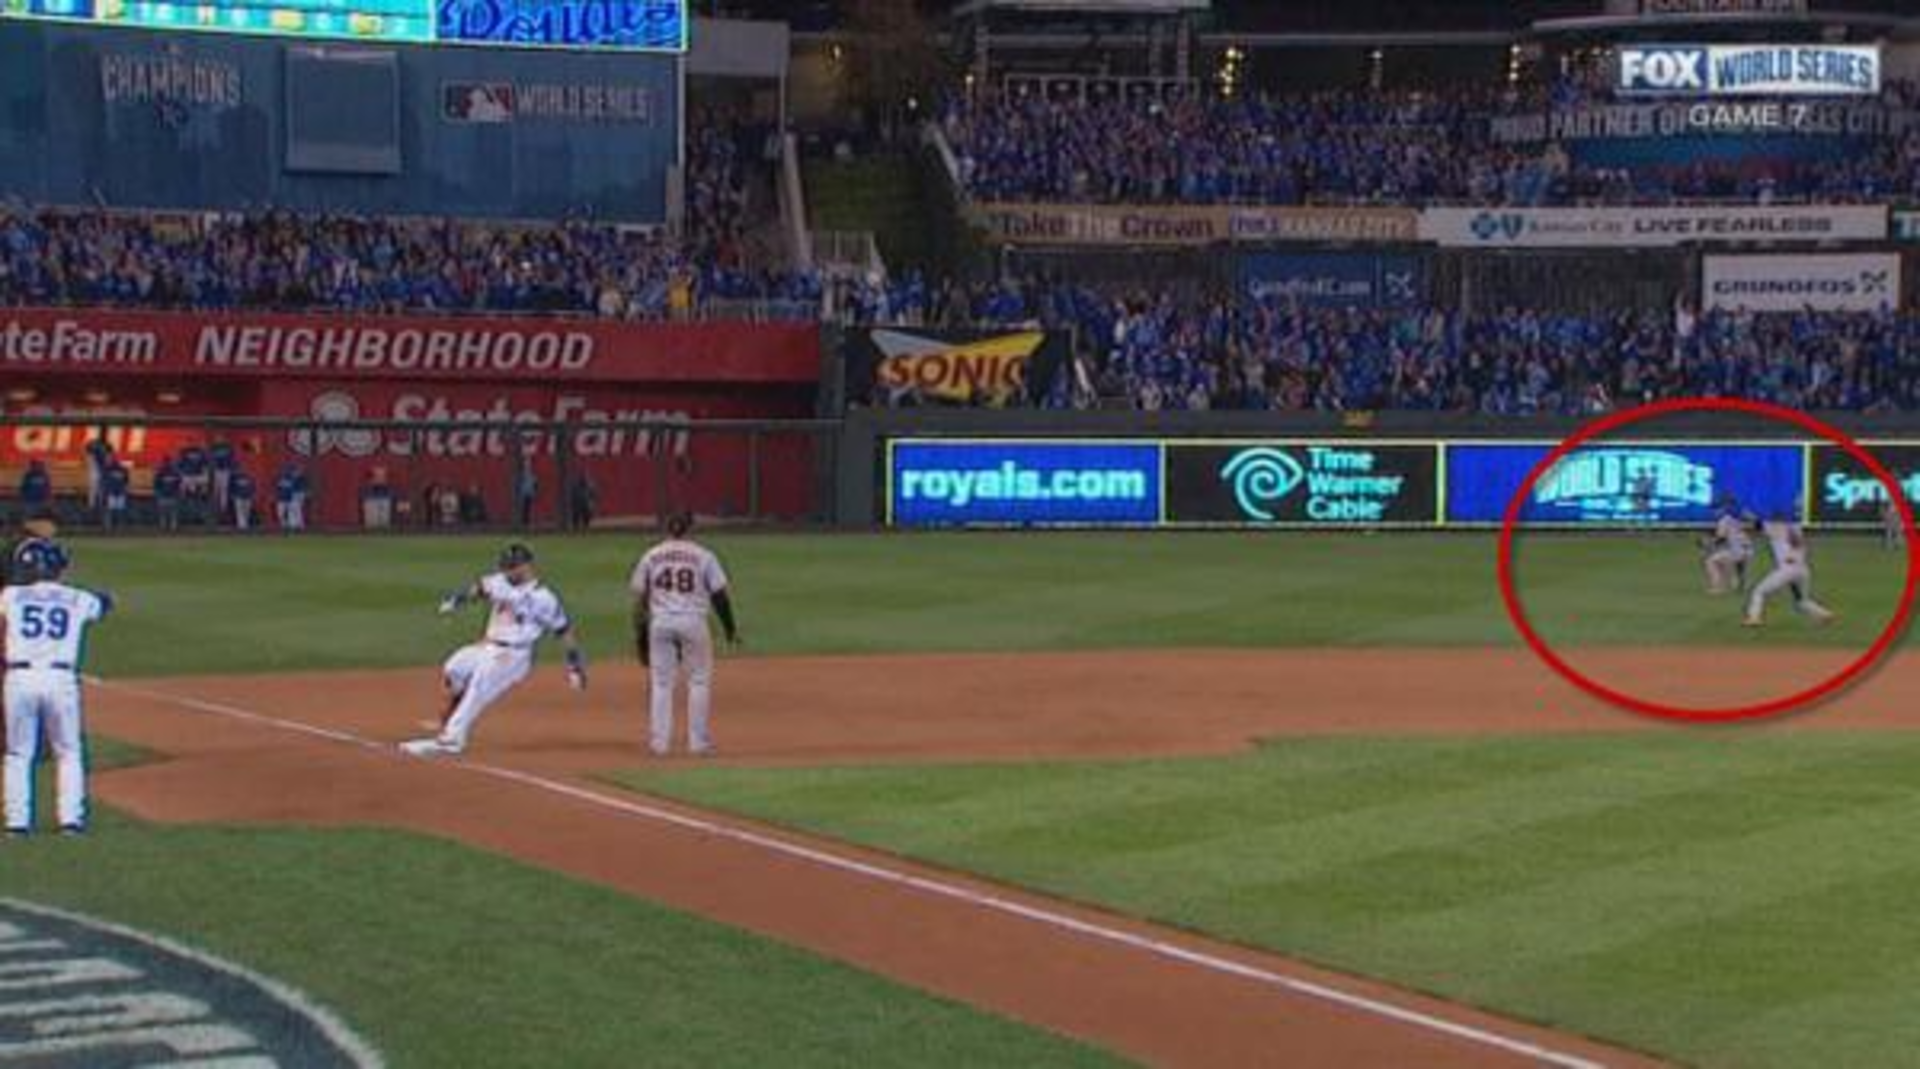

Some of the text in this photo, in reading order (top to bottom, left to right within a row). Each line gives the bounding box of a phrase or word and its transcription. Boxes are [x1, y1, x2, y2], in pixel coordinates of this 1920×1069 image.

[102, 54, 242, 106] CHAMPIONS
[1635, 217, 1691, 234] LIVE
[1697, 217, 1832, 233] FEARLESS
[1713, 280, 1856, 295] GRUNDFOS
[195, 327, 593, 370] NEIGHBORHOOD
[877, 352, 1026, 389] SONIC
[1306, 446, 1374, 471] Time
[901, 459, 1146, 507] royals.com
[1307, 472, 1403, 495] Warner
[1306, 496, 1383, 520] Cable
[655, 567, 695, 595] 48
[20, 604, 70, 641] 59
